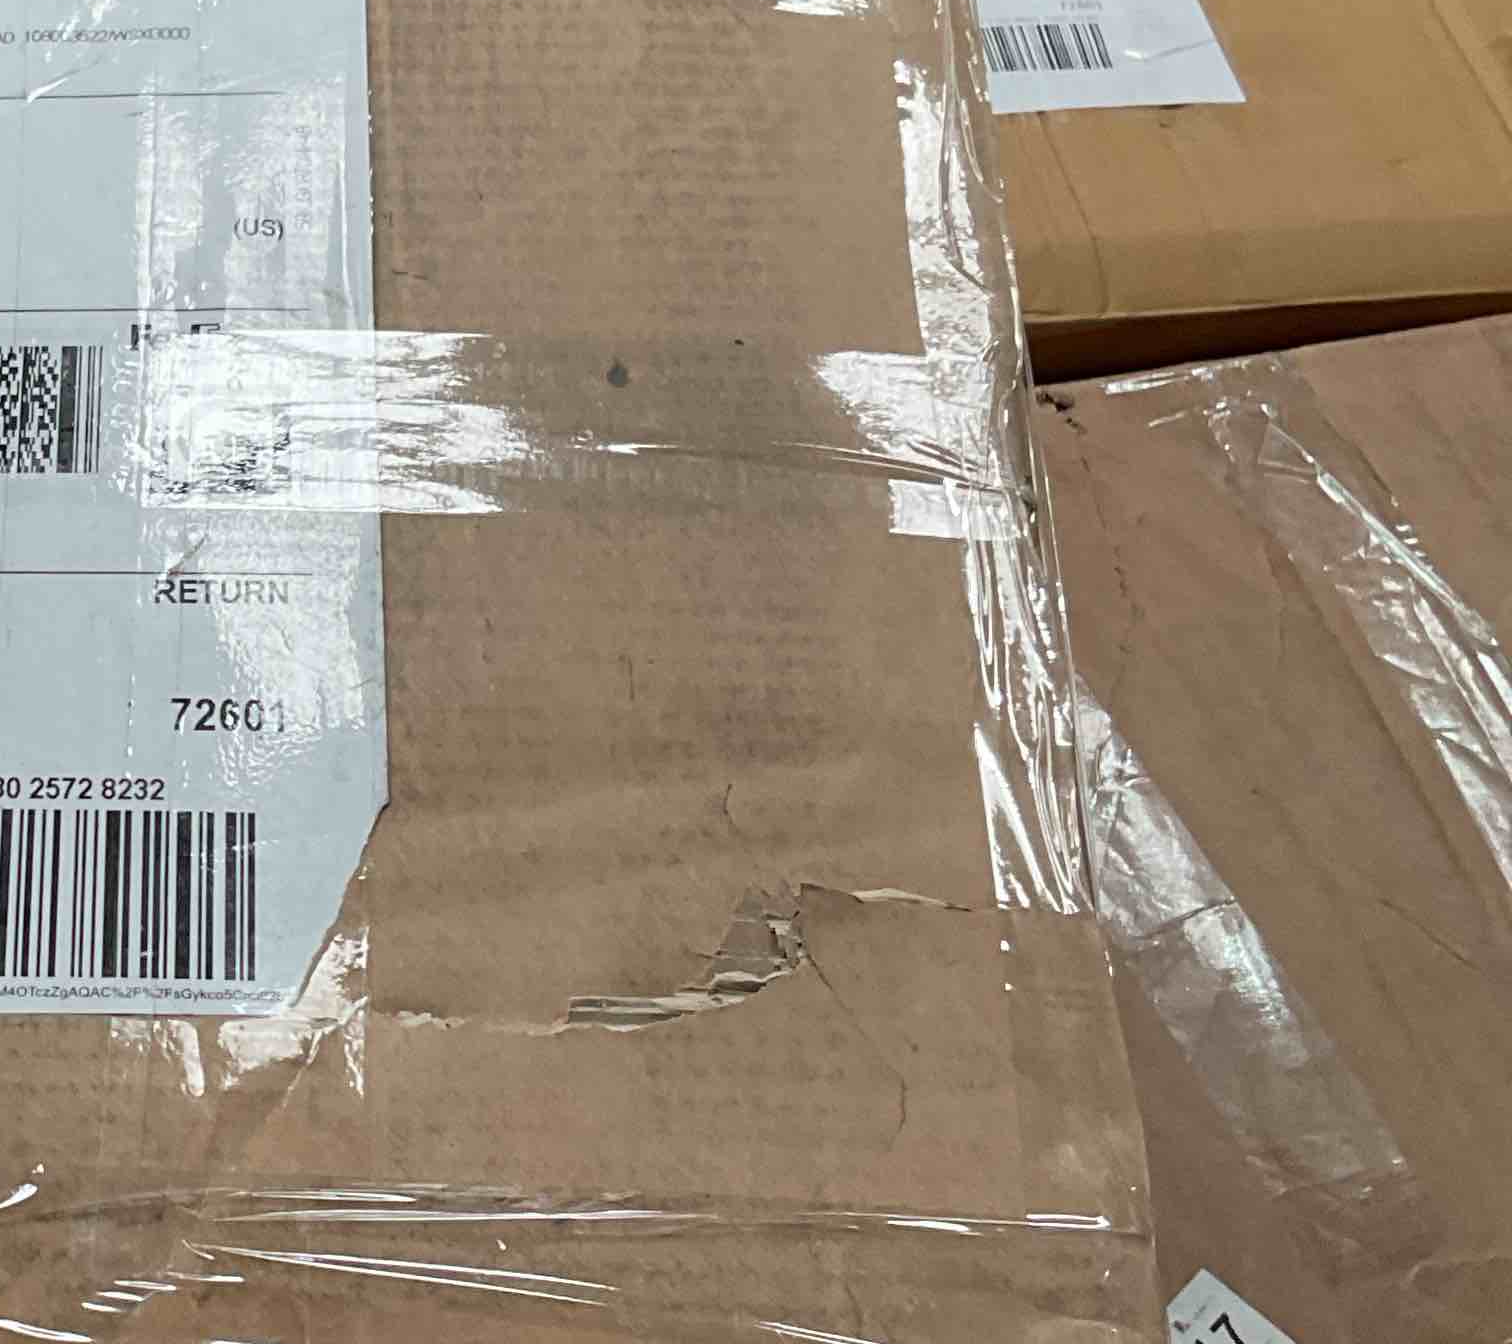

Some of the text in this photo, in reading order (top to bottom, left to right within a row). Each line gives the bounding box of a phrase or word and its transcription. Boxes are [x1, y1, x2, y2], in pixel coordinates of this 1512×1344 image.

[233, 218, 284, 241] (US)
[153, 578, 290, 605] RETURN
[170, 696, 288, 734] 72601
[29, 776, 94, 799] 2572
[101, 777, 166, 801] 8232
